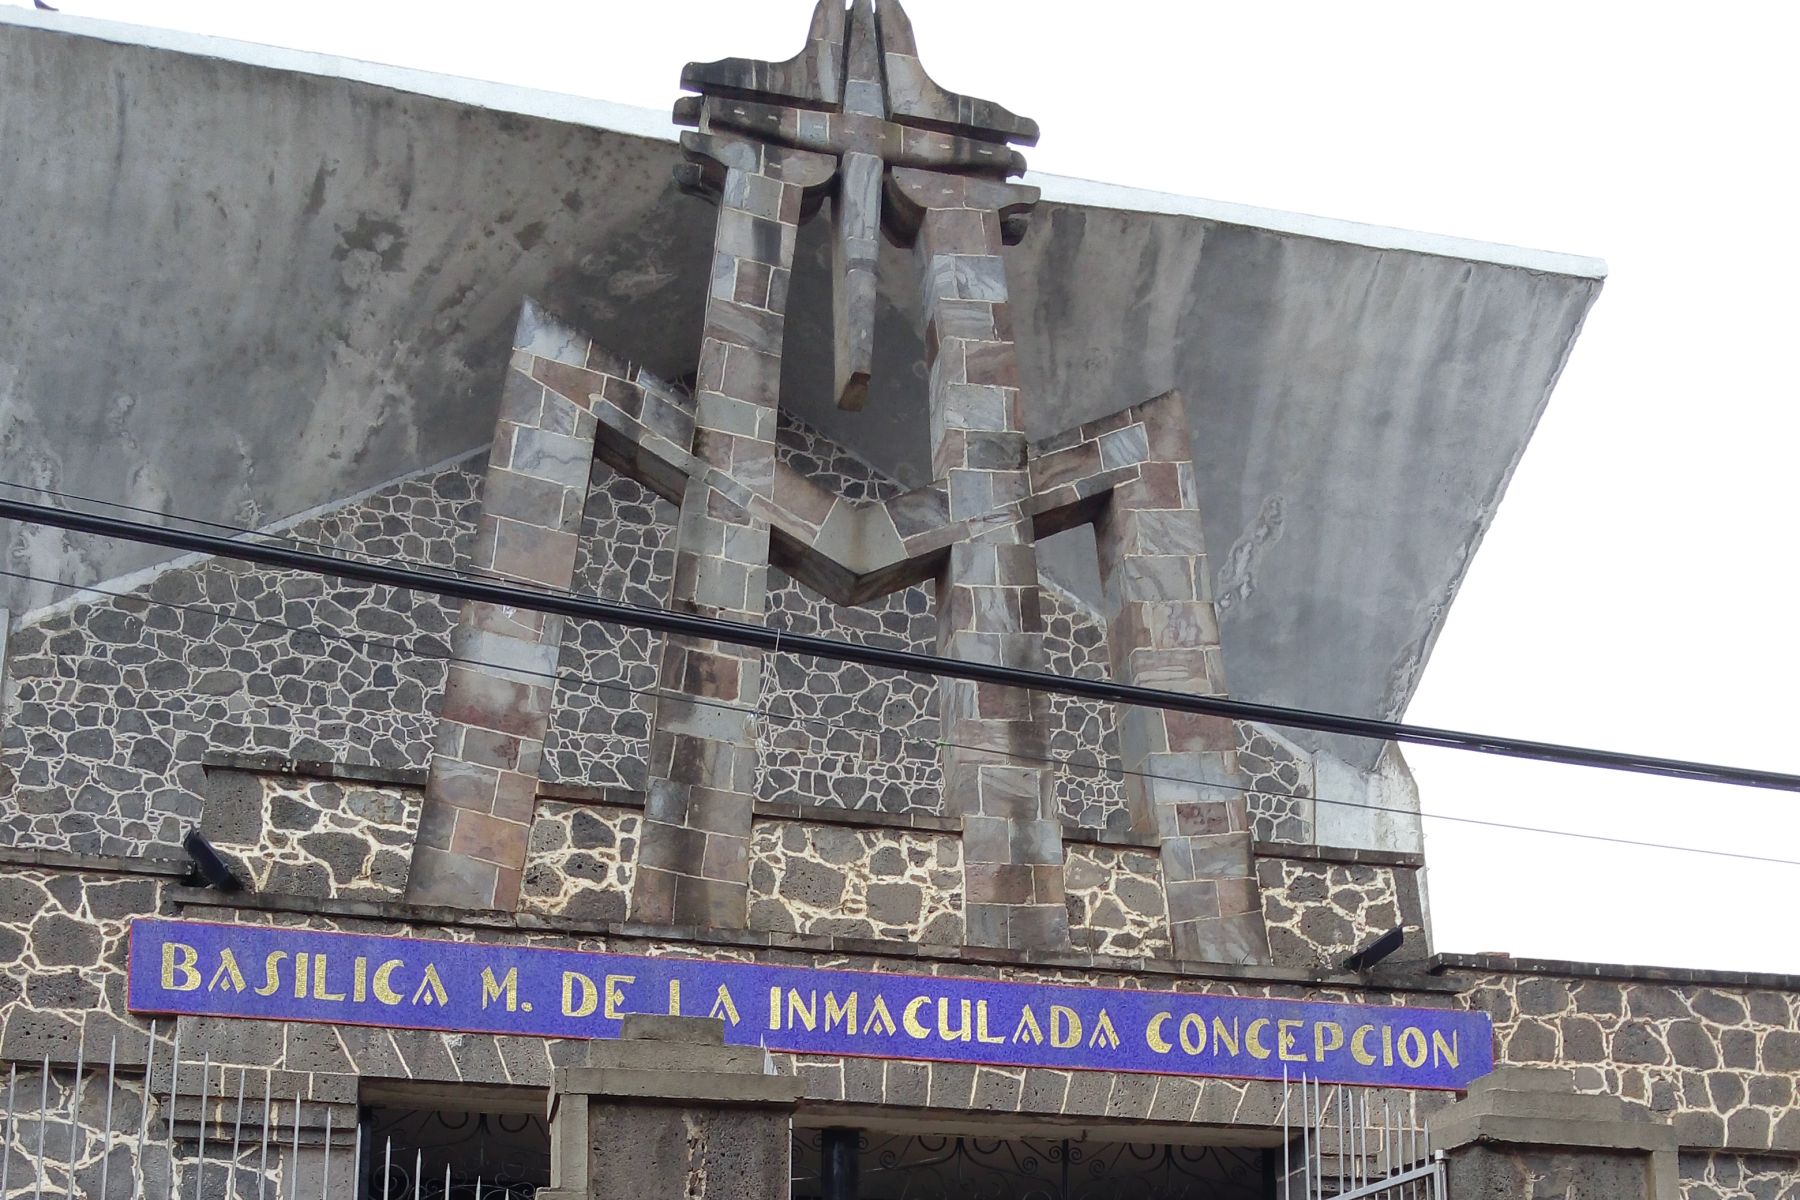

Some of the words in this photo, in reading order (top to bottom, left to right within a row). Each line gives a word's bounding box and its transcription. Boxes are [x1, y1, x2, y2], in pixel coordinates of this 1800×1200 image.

[161, 942, 448, 1007] BASILICA
[479, 965, 534, 1014] M.
[561, 970, 637, 1020] DE
[768, 985, 1121, 1050] INMACULADA
[1145, 1010, 1459, 1069] CONCEPCION
